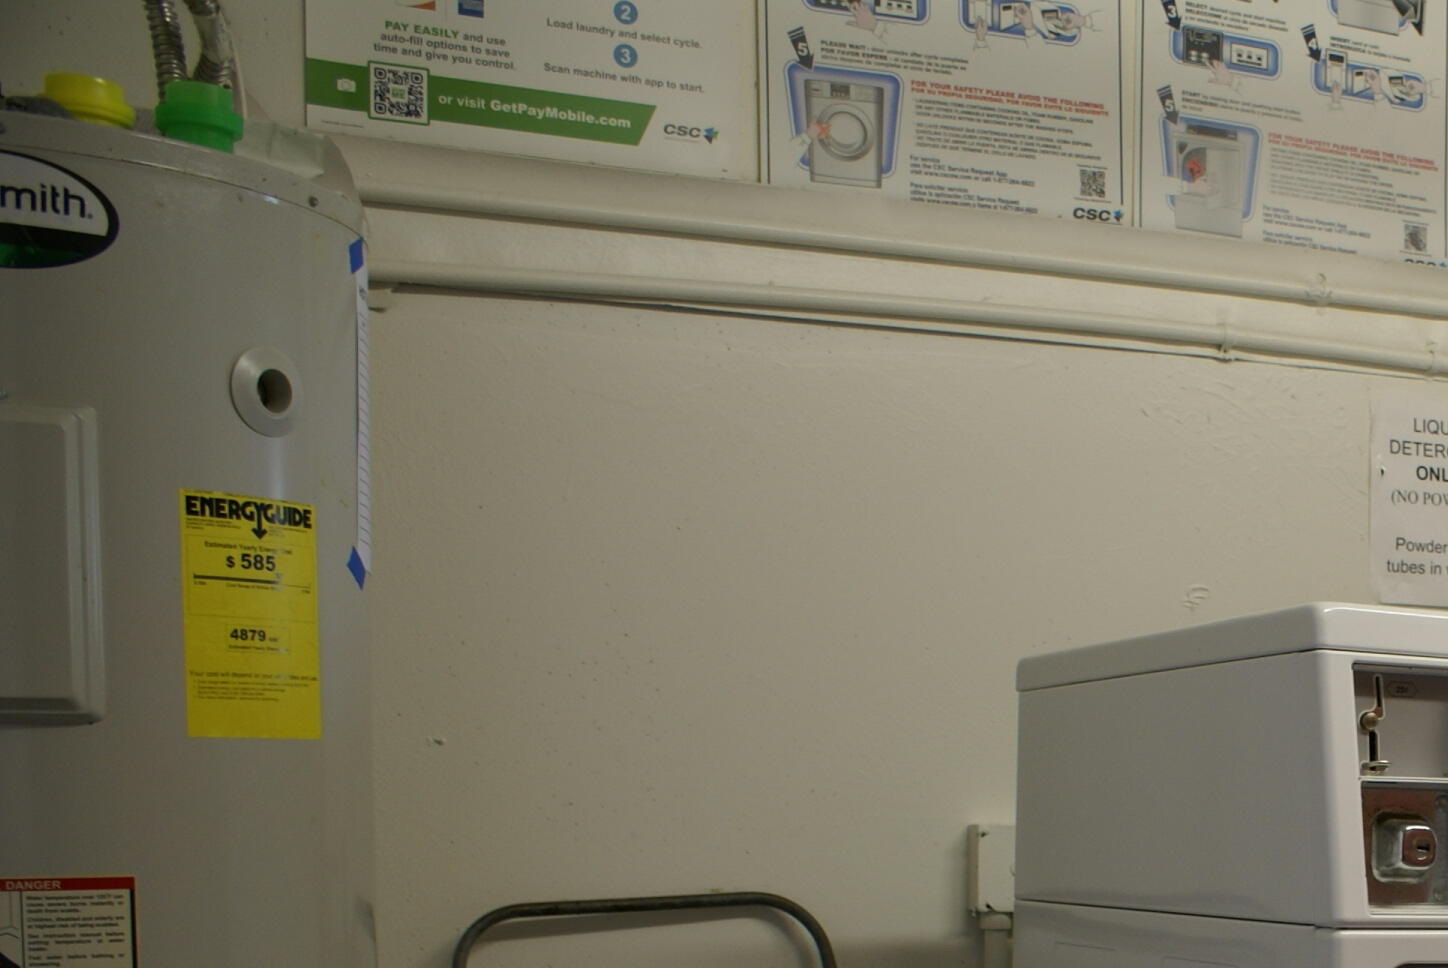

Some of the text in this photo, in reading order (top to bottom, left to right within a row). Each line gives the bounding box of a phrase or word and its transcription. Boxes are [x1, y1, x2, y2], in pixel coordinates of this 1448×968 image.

[621, 5, 631, 20] 2
[1168, 6, 1176, 18] 3
[385, 20, 506, 46] PAY EASILY and use
[547, 18, 703, 49] Load laundry and select cycle.
[381, 33, 510, 58] auto-fill options to save
[798, 43, 808, 56] 5
[374, 44, 516, 70] time and give you control.
[621, 49, 631, 63] 3
[544, 63, 704, 93] Scan machine with app to start.
[911, 80, 927, 88] FOR
[930, 82, 951, 90] YOUR
[954, 85, 984, 94] SAFETY
[986, 89, 1015, 99] PLEASE
[439, 95, 631, 129] or visit GetPayMobile.com
[1165, 99, 1174, 112] 5
[664, 124, 701, 138] CSC
[0, 183, 86, 218] mith
[1073, 207, 1111, 221] CSC
[1391, 489, 1419, 506] (NO
[184, 495, 312, 530] ENERGYGUIDE
[205, 541, 237, 549] Estimated
[239, 543, 257, 552] Yearly
[1396, 537, 1448, 554] Powder
[226, 553, 276, 572] $ 585
[1387, 560, 1426, 575] tubes
[1430, 562, 1442, 576] in
[230, 628, 266, 642] 4879
[5, 879, 62, 891] DANGER
